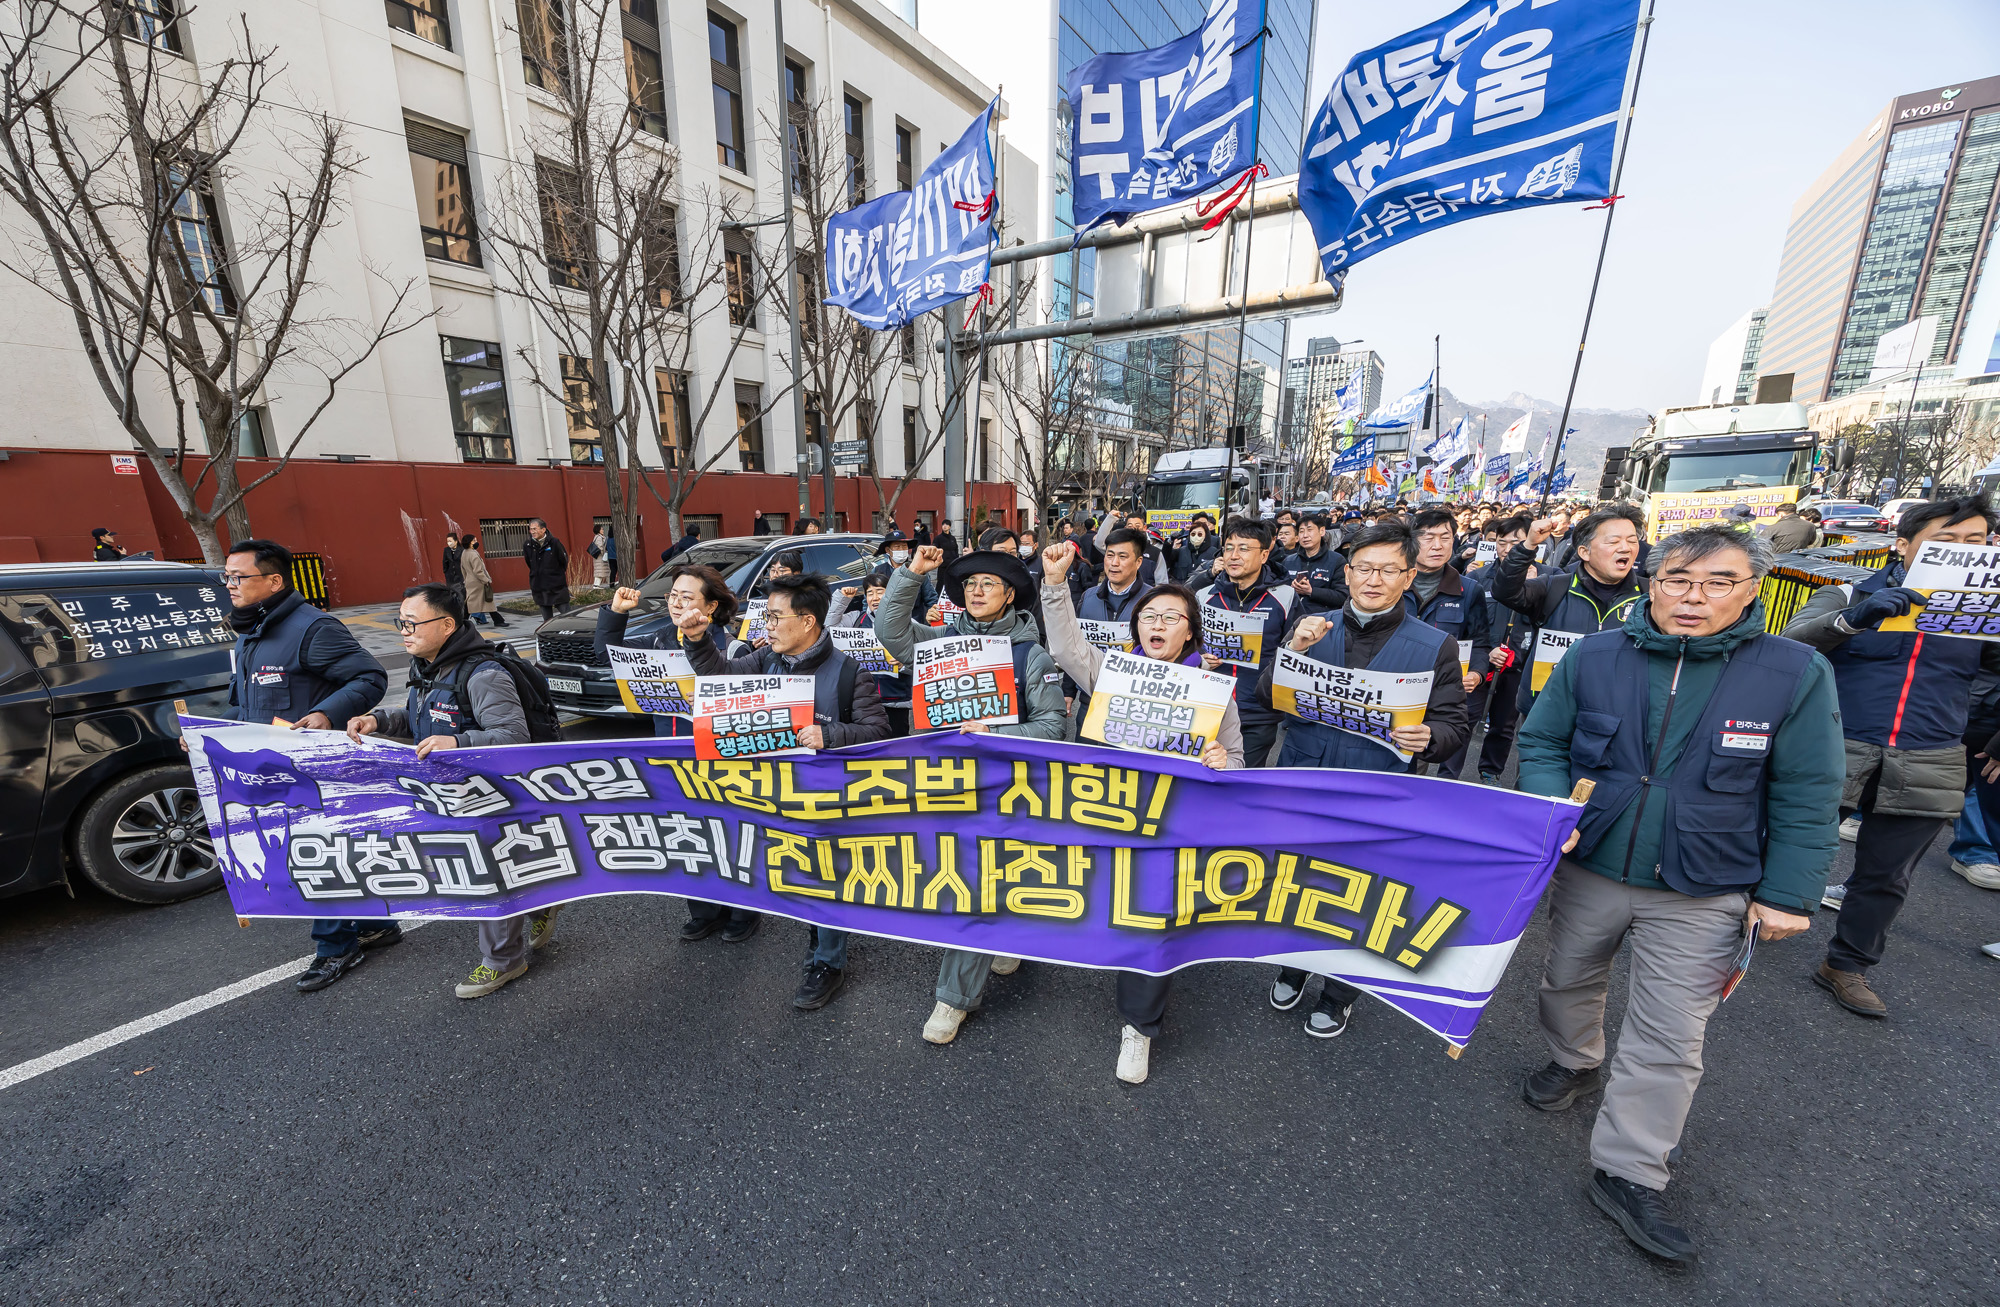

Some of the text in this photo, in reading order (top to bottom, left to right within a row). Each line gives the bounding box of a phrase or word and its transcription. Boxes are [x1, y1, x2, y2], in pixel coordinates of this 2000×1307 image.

[1901, 101, 1954, 119] KYOBO
[69, 607, 223, 640] 전국건설노동조합
[832, 629, 864, 640] 진짜사장
[849, 638, 878, 649] 나와라!
[916, 638, 983, 665] 모든 노동자의
[1541, 632, 1576, 649] 진짜
[610, 648, 647, 666] 진짜사장
[918, 656, 969, 682] 노동기본권
[1105, 654, 1170, 681] 진짜사장
[1279, 653, 1355, 686] 진짜사장
[634, 665, 667, 679] 나와라!
[1209, 675, 1231, 686] 민주노총
[1405, 677, 1429, 685] 민주노총
[628, 680, 682, 699] 원청교섭
[699, 681, 727, 698] 모든
[729, 677, 782, 693] 노동자의
[924, 671, 998, 703] 투쟁으로
[1130, 679, 1190, 701] 나와라!
[1314, 681, 1382, 705] 나와라!
[702, 694, 765, 714] 노동기본권
[927, 693, 1010, 727] 쟁취하자!
[1108, 695, 1195, 730] 원청교섭
[1295, 690, 1393, 728] 원청교섭
[712, 708, 792, 736] 투쟁으로
[1296, 705, 1394, 743] 쟁취하자
[1736, 720, 1770, 730] 민주노총
[715, 730, 800, 757] 쟁취하자
[1104, 719, 1205, 757] 쟁취하자!
[237, 770, 297, 786] 민주노총
[399, 757, 1174, 837] 3월 10일 개정노조법 시행!
[290, 814, 1463, 969] 원청교섭 쟁취! 진짜사장 나와라!
